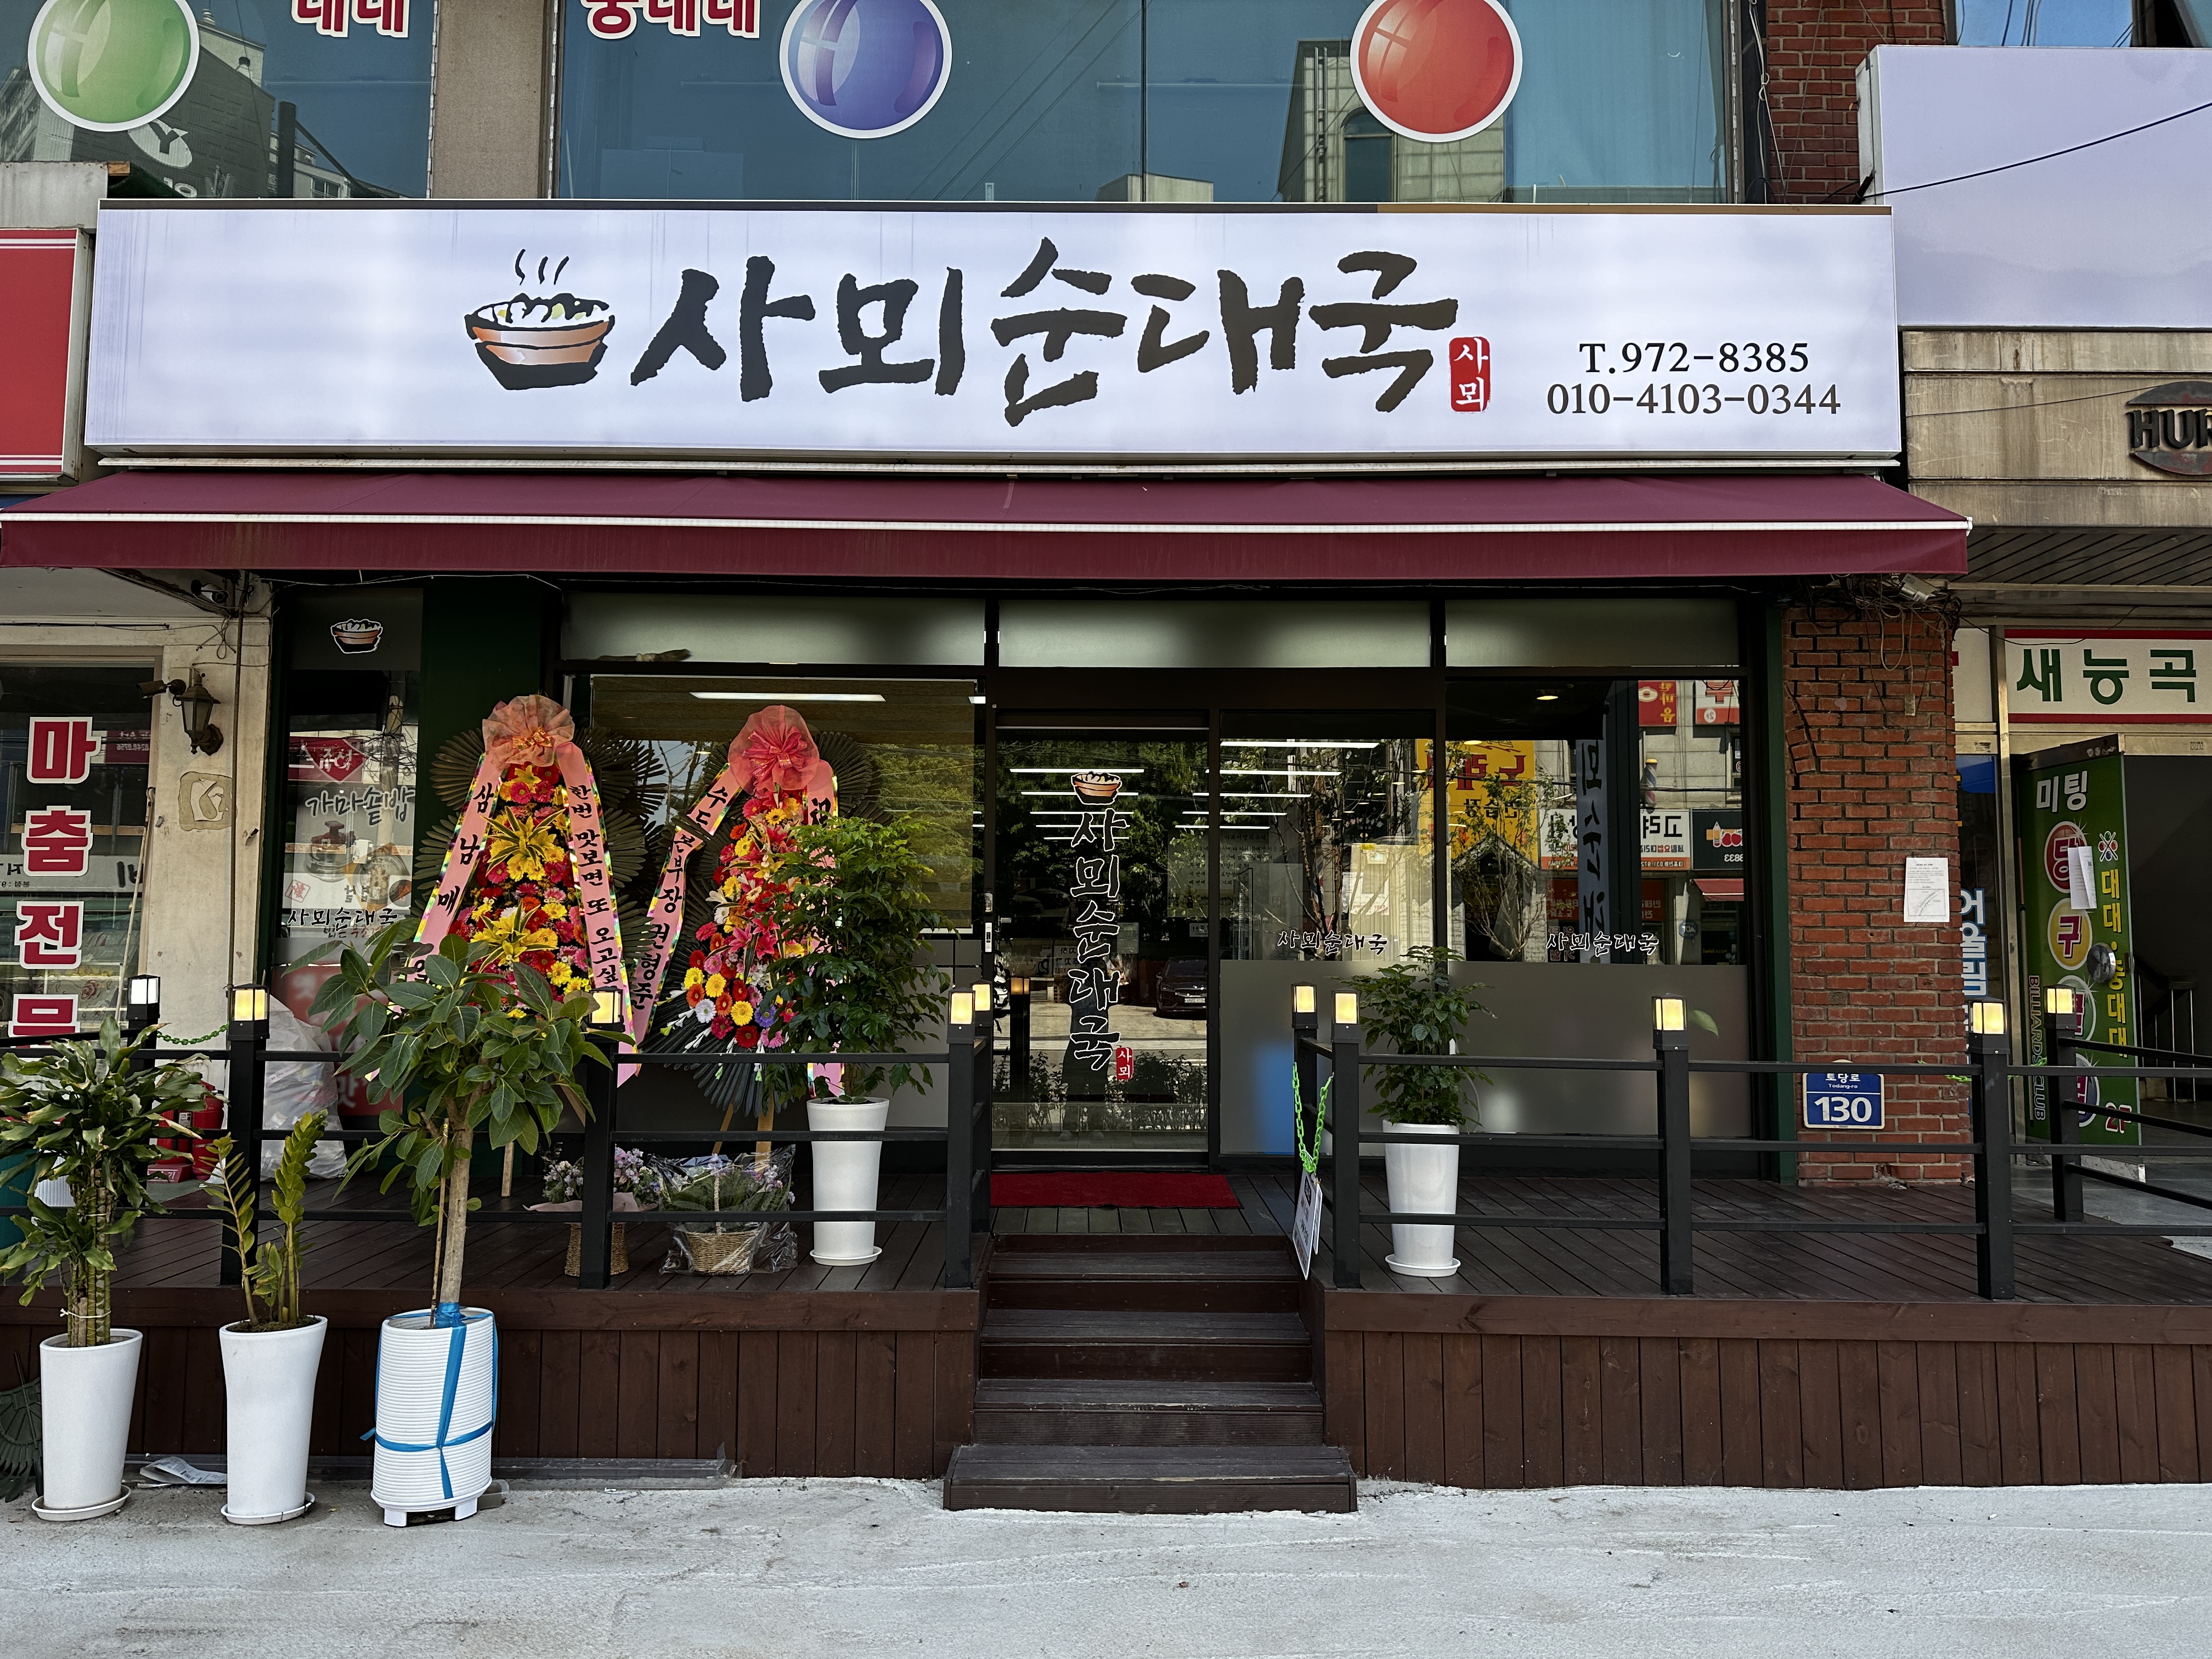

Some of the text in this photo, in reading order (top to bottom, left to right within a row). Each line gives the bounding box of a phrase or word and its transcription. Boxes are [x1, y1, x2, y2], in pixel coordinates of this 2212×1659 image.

[630, 237, 1458, 427] 사뫼순대국
[1579, 342, 1809, 374] T.972-8385
[1454, 337, 1489, 413] 사뫼
[1547, 383, 1841, 414] 010-4103-0344
[2017, 649, 2197, 704] 새능곡
[568, 785, 592, 819] 한번
[2036, 771, 2088, 814] 미팅
[573, 828, 604, 887] 맛보면
[287, 907, 399, 932] 사뫼순대국
[585, 896, 610, 915] 또
[1068, 808, 1127, 1071] 사뫼순대국
[1277, 930, 1387, 955] 사뫼순대국
[1545, 932, 1659, 956] 사뫼순대국
[2028, 975, 2044, 1066] BILLIARDS
[1117, 1047, 1133, 1080] 사뫼
[1826, 1073, 1861, 1084] 토당로
[1814, 1096, 1872, 1123] 130
